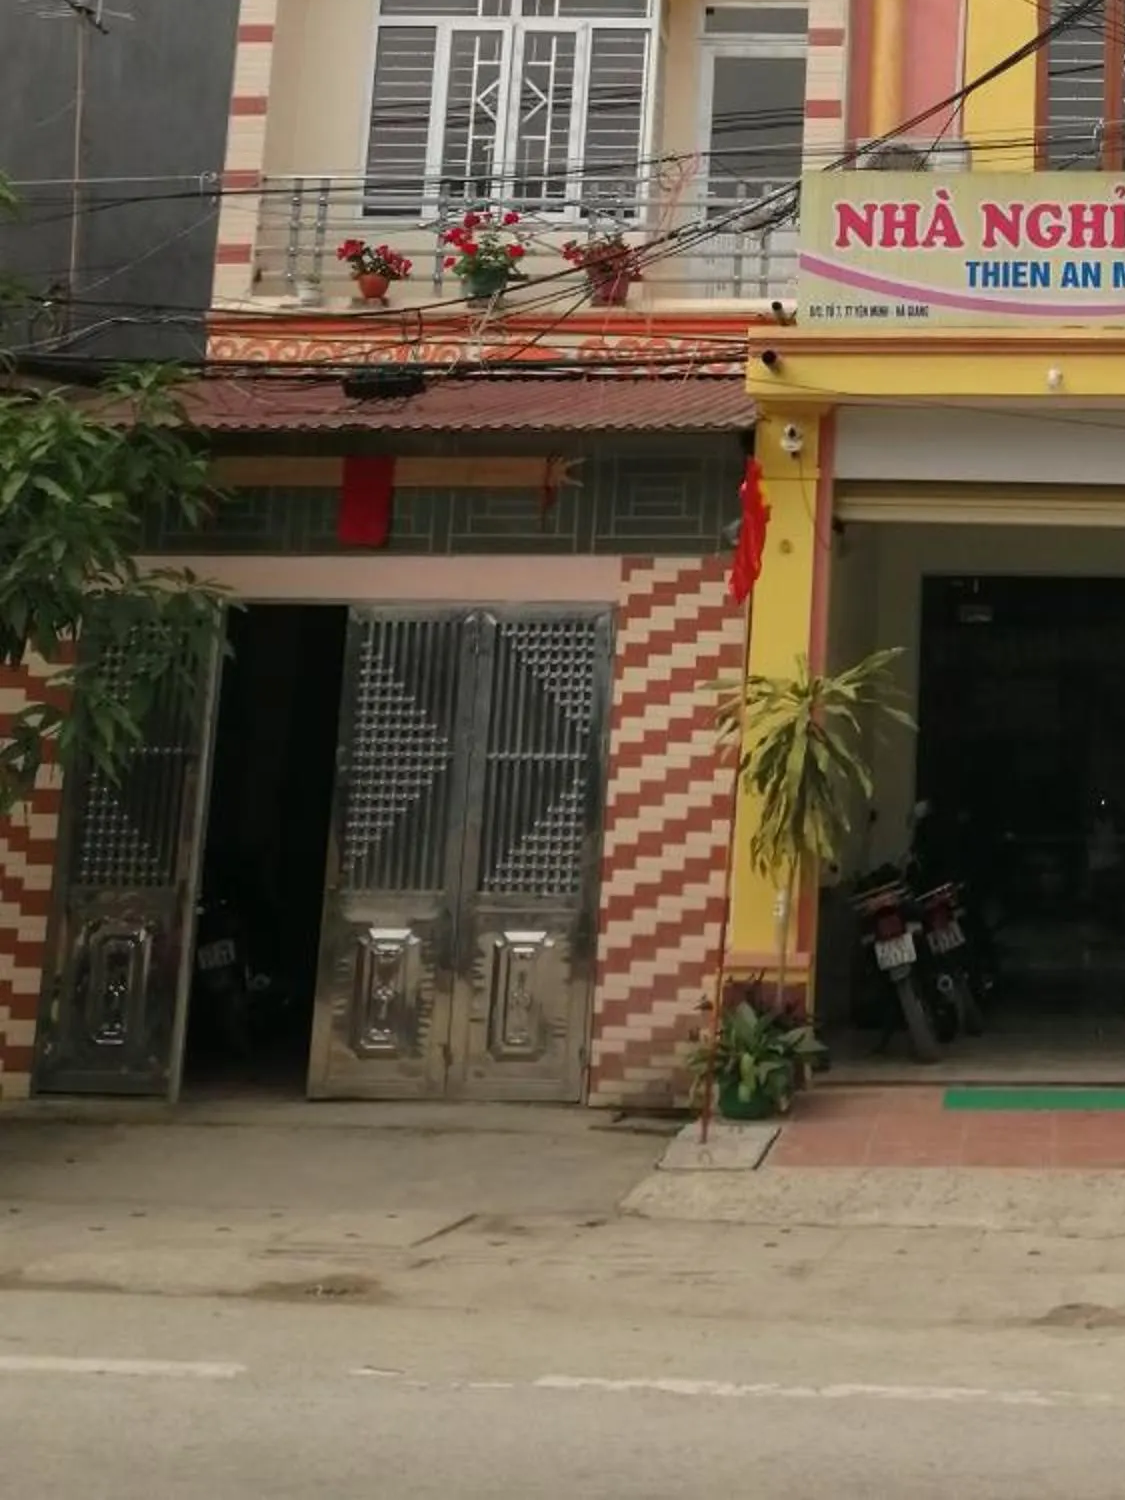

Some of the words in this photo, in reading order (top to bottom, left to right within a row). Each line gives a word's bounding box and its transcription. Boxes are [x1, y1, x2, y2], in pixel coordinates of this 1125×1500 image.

[834, 190, 965, 249] NHÀ
[965, 260, 1051, 289] THIEN
[1060, 260, 1103, 289] AN
